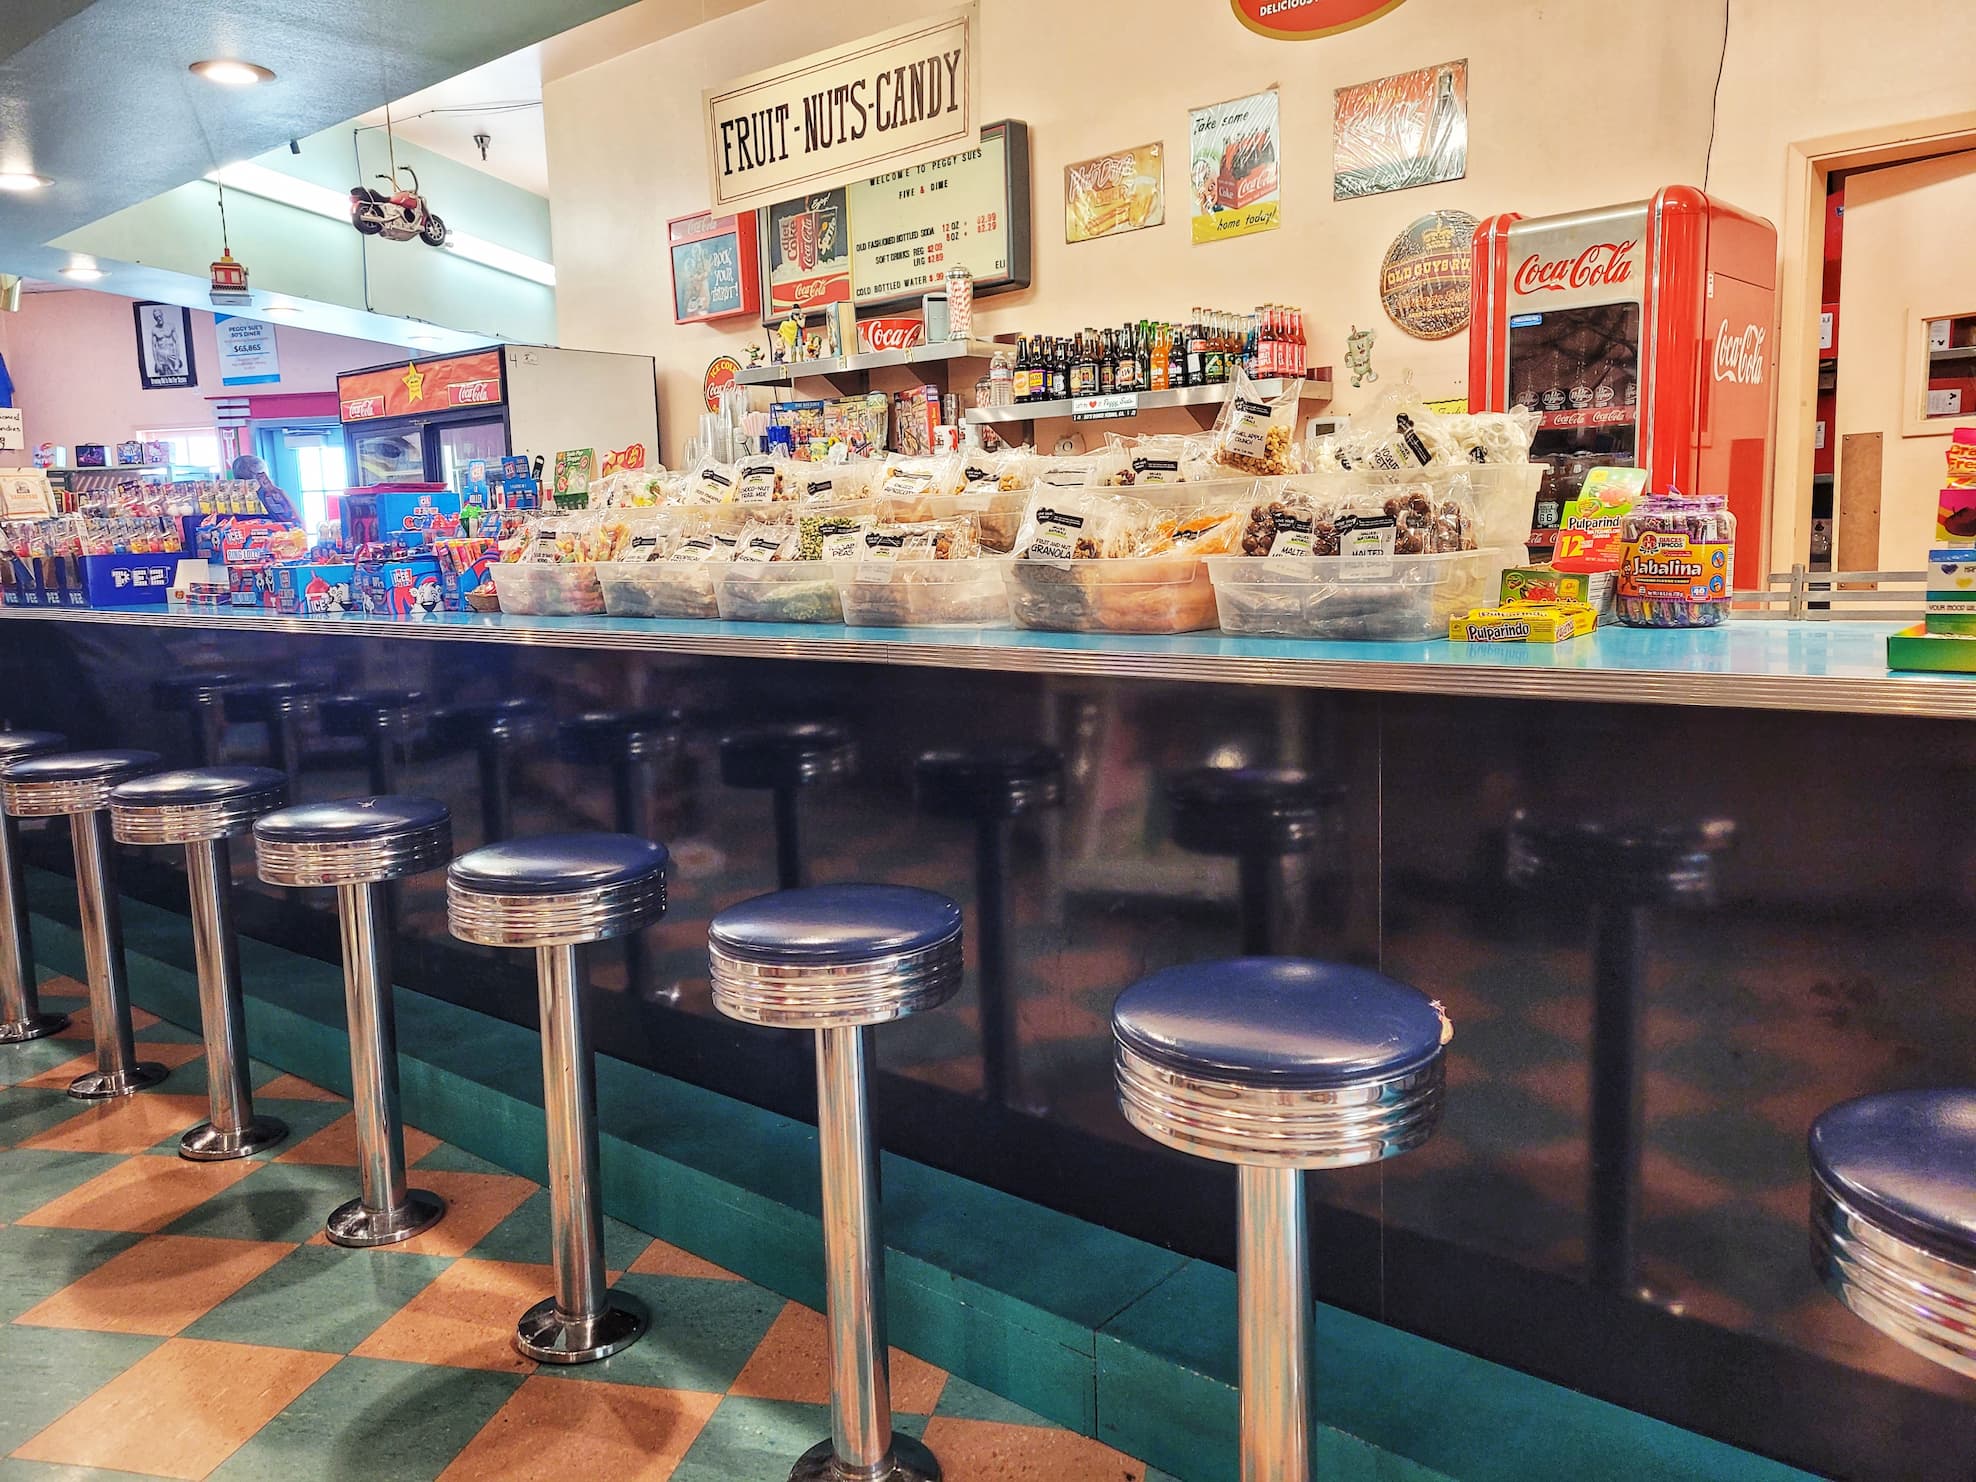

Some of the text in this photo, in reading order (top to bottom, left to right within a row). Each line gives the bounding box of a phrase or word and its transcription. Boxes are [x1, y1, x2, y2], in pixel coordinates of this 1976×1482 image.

[1194, 111, 1249, 135] Take some
[869, 147, 982, 187] WELCOME TO PEGGY SUES
[899, 179, 949, 200] FIVE & DIME
[951, 221, 959, 230] OZ
[1217, 208, 1276, 231] home today!
[856, 243, 866, 252] OLD
[896, 231, 919, 243] BOTTLED
[921, 227, 935, 237] SODA
[951, 232, 958, 240] OZ
[875, 255, 889, 265] SOFT
[913, 247, 924, 256] REG
[914, 257, 925, 267] LRG
[1388, 258, 1471, 285] OLD GUYS RU
[1513, 239, 1638, 295] Coca-Cola
[794, 279, 826, 300] Coca-Cola
[856, 287, 871, 296] COLD
[874, 281, 901, 293] BOTTLED
[904, 275, 927, 287] WATER
[1713, 318, 1767, 384] Coca-Cola
[710, 364, 721, 378] ICE
[458, 382, 488, 403] Coca-Cola
[349, 400, 374, 418] Coca-Cola
[1592, 410, 1625, 423] Coca-Cola
[1554, 413, 1585, 425] Coca-Cola
[1568, 515, 1621, 531] Pulparind
[1031, 544, 1071, 559] GRANOLA
[1036, 538, 1050, 546] FRUIT
[1281, 547, 1305, 556] MALTE
[1560, 535, 1585, 558] 12
[393, 570, 411, 582] ICEE
[1633, 556, 1702, 577] Jabalina
[111, 566, 170, 588] PEZ
[1466, 622, 1530, 640] Pulparindo
